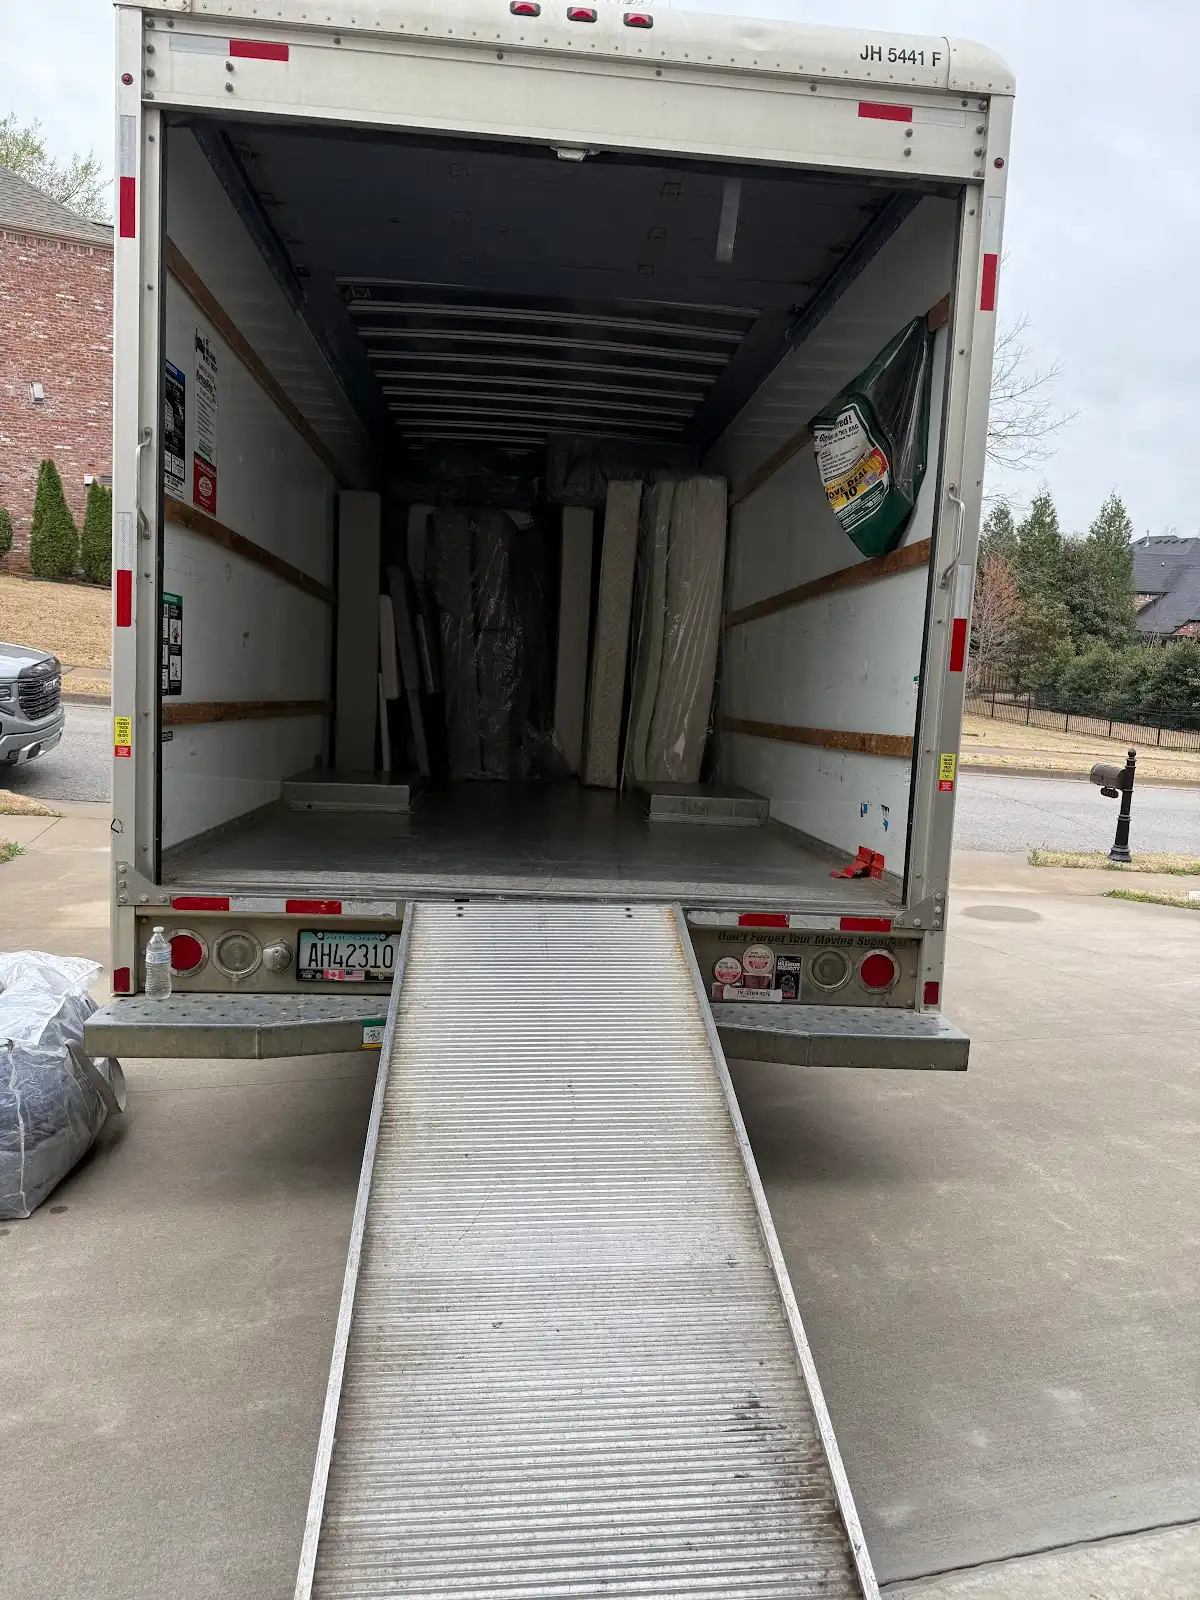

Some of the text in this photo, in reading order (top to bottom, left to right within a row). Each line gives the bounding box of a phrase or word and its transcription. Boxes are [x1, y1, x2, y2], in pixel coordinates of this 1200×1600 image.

[860, 45, 941, 66] JH 5441 F
[718, 931, 747, 942] Don't
[751, 933, 785, 944] Forget
[788, 933, 810, 944] Your
[814, 935, 853, 948] Moving
[308, 942, 394, 968] AH42310
